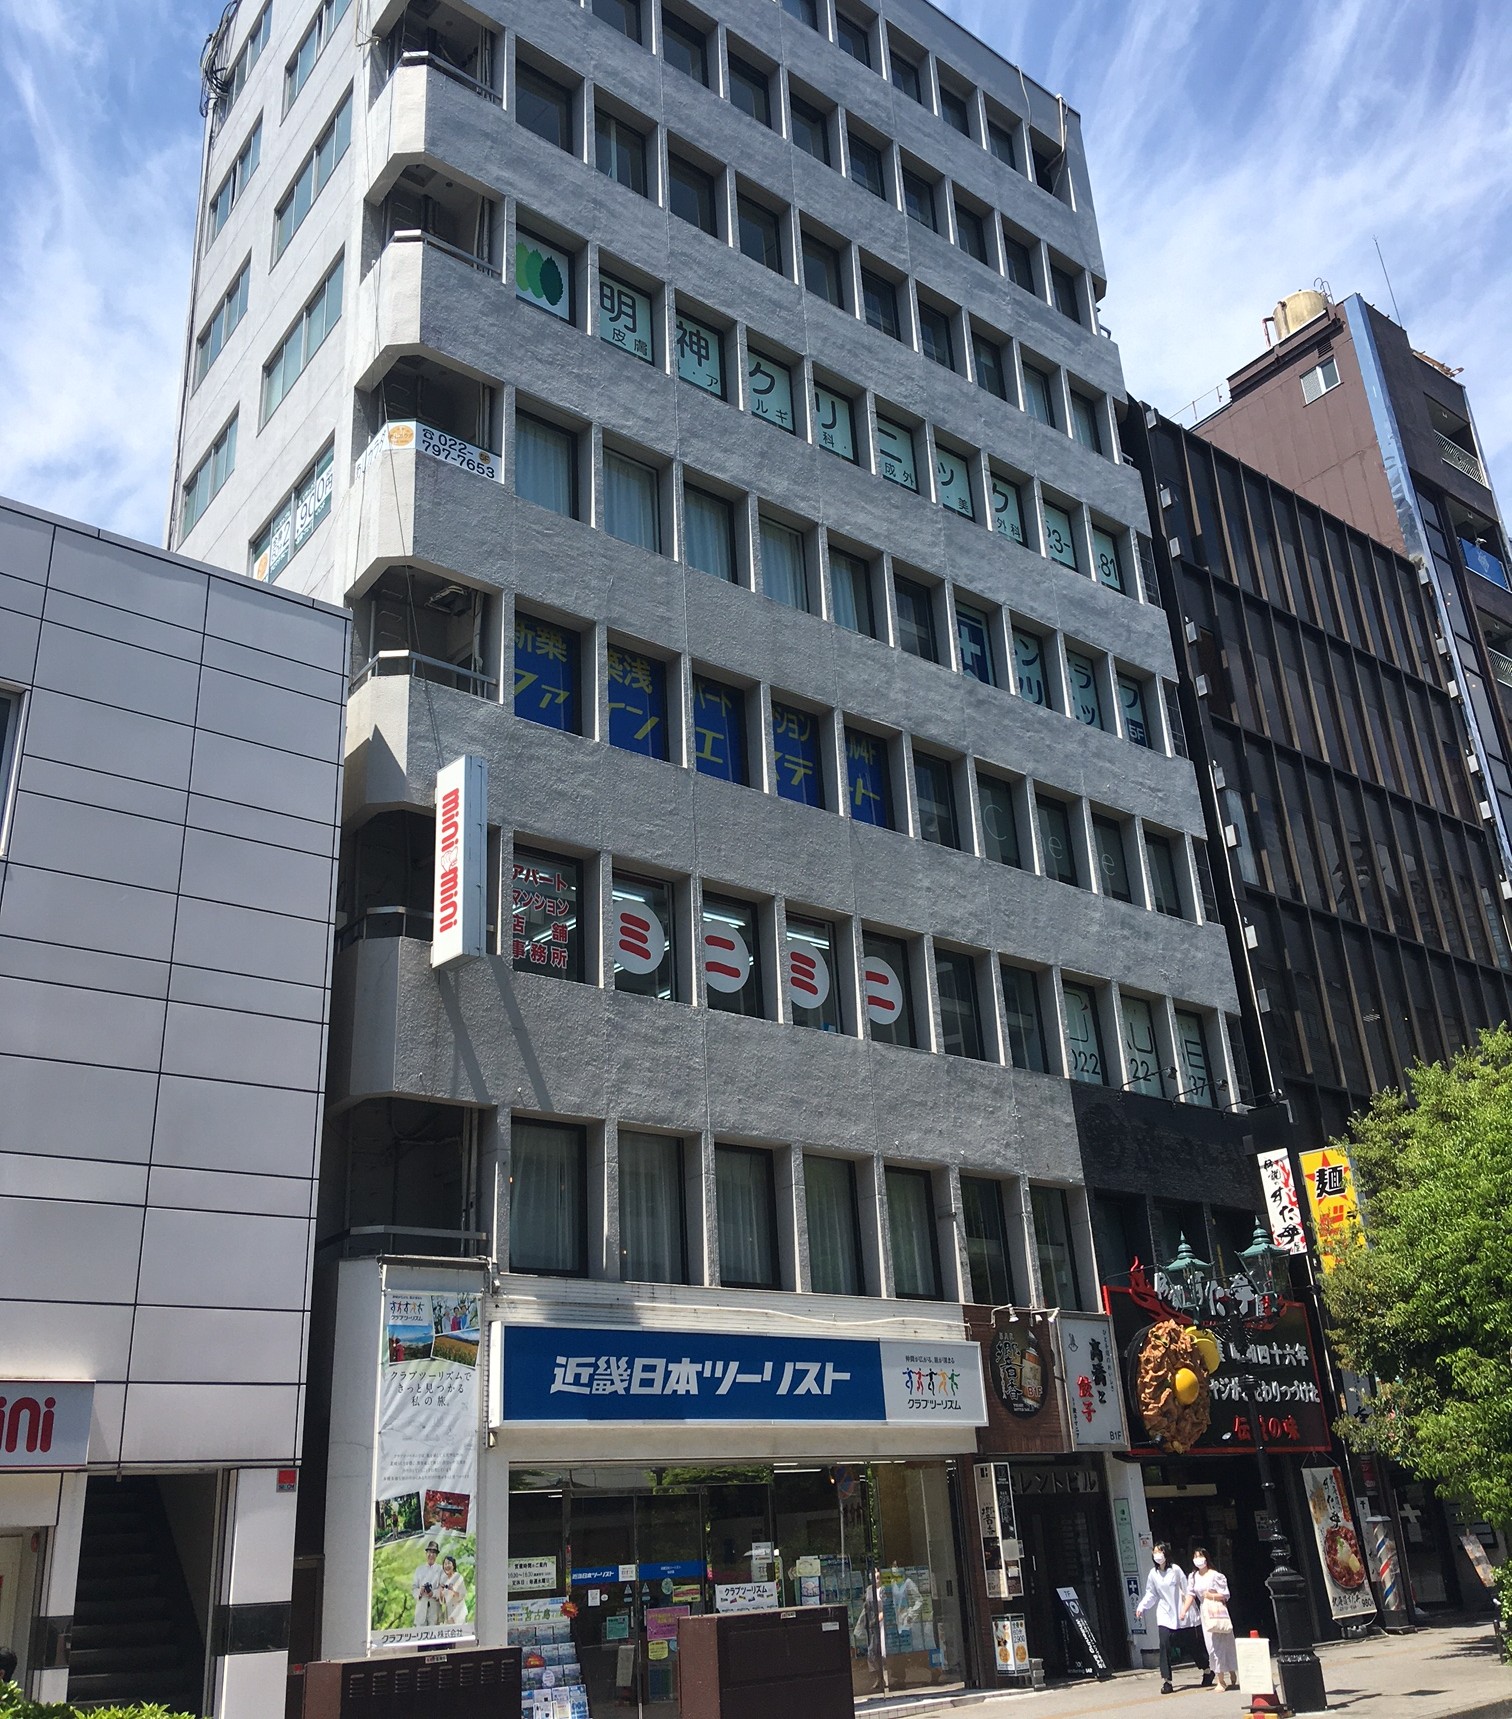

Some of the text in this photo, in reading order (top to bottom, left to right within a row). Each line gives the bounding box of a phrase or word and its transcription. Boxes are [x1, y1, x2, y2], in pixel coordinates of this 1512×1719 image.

[600, 280, 637, 333] 明
[677, 320, 710, 367] 神
[749, 361, 776, 395] ク
[815, 392, 837, 430] リ
[422, 439, 495, 479] 797-7653
[438, 434, 473, 456] 022-
[1129, 724, 1144, 741] 5F
[439, 788, 460, 933] mini mini
[512, 864, 568, 892] アパート
[512, 889, 569, 917] マンション
[512, 940, 568, 969] 事務所
[1316, 1165, 1346, 1198] 麺
[390, 1370, 472, 1381] クラブツーリズムで
[550, 1354, 851, 1396] 近畿日本ツーリスト
[907, 1399, 961, 1410] クラブツーリズム
[1077, 1375, 1096, 1423] 餃子
[1233, 1414, 1300, 1441] 伝の味
[724, 1585, 768, 1596] クラブツーリズム
